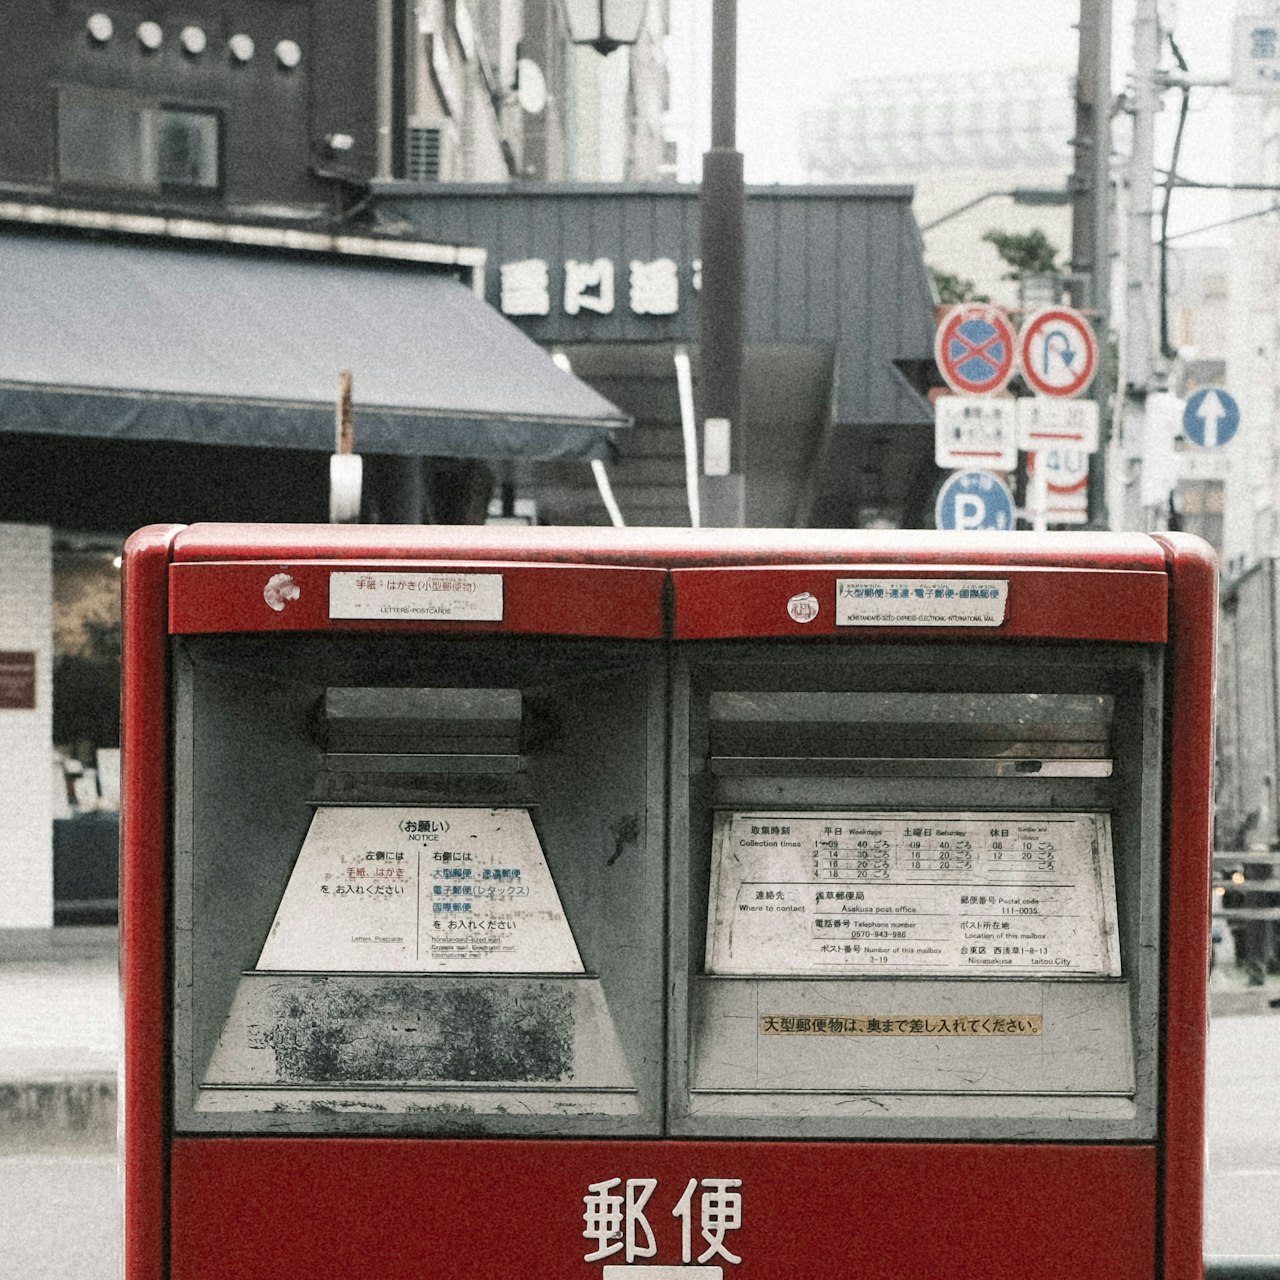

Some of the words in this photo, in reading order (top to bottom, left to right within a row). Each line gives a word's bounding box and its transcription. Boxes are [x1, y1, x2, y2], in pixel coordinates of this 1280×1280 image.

[751, 826, 790, 835] 取集時刻
[824, 827, 842, 836] 平日
[903, 828, 931, 837] 土曜日
[990, 829, 1009, 837] 休日
[408, 834, 440, 842] NOTICE
[739, 840, 777, 848] Collection
[780, 840, 801, 848] times
[992, 842, 1003, 850] 08
[1022, 842, 1032, 850] 10
[365, 851, 405, 861] 左側には
[432, 852, 472, 861] 右側には
[992, 852, 1003, 860] 12
[1022, 852, 1032, 860] 20
[1037, 862, 1054, 870] ごろ
[347, 867, 405, 877] 手紙、はがき
[320, 885, 329, 894] を
[335, 885, 404, 895] お入れください
[756, 891, 784, 900] 連絡先
[816, 892, 865, 901] 浅草郵便局
[961, 896, 996, 905] 郵便番号
[432, 903, 472, 912] 国際郵便
[739, 904, 762, 912] Where
[875, 906, 893, 914] post
[1002, 907, 1038, 915] 111-0035
[432, 920, 442, 929] を
[448, 920, 516, 930] お入れください
[815, 920, 850, 928] 電話番号
[854, 921, 889, 929] Telephone
[960, 921, 1010, 930] ポスト所在地
[965, 932, 993, 940] Location
[1005, 932, 1018, 940] this
[1020, 932, 1046, 940] mailbox
[821, 945, 860, 953] ポスト番号
[960, 946, 986, 955] 台東区
[869, 955, 888, 963] 3-19
[764, 1018, 1039, 1033] 大型郵便物は、奥まで差し入れてください。
[582, 1177, 742, 1264] 郵便
